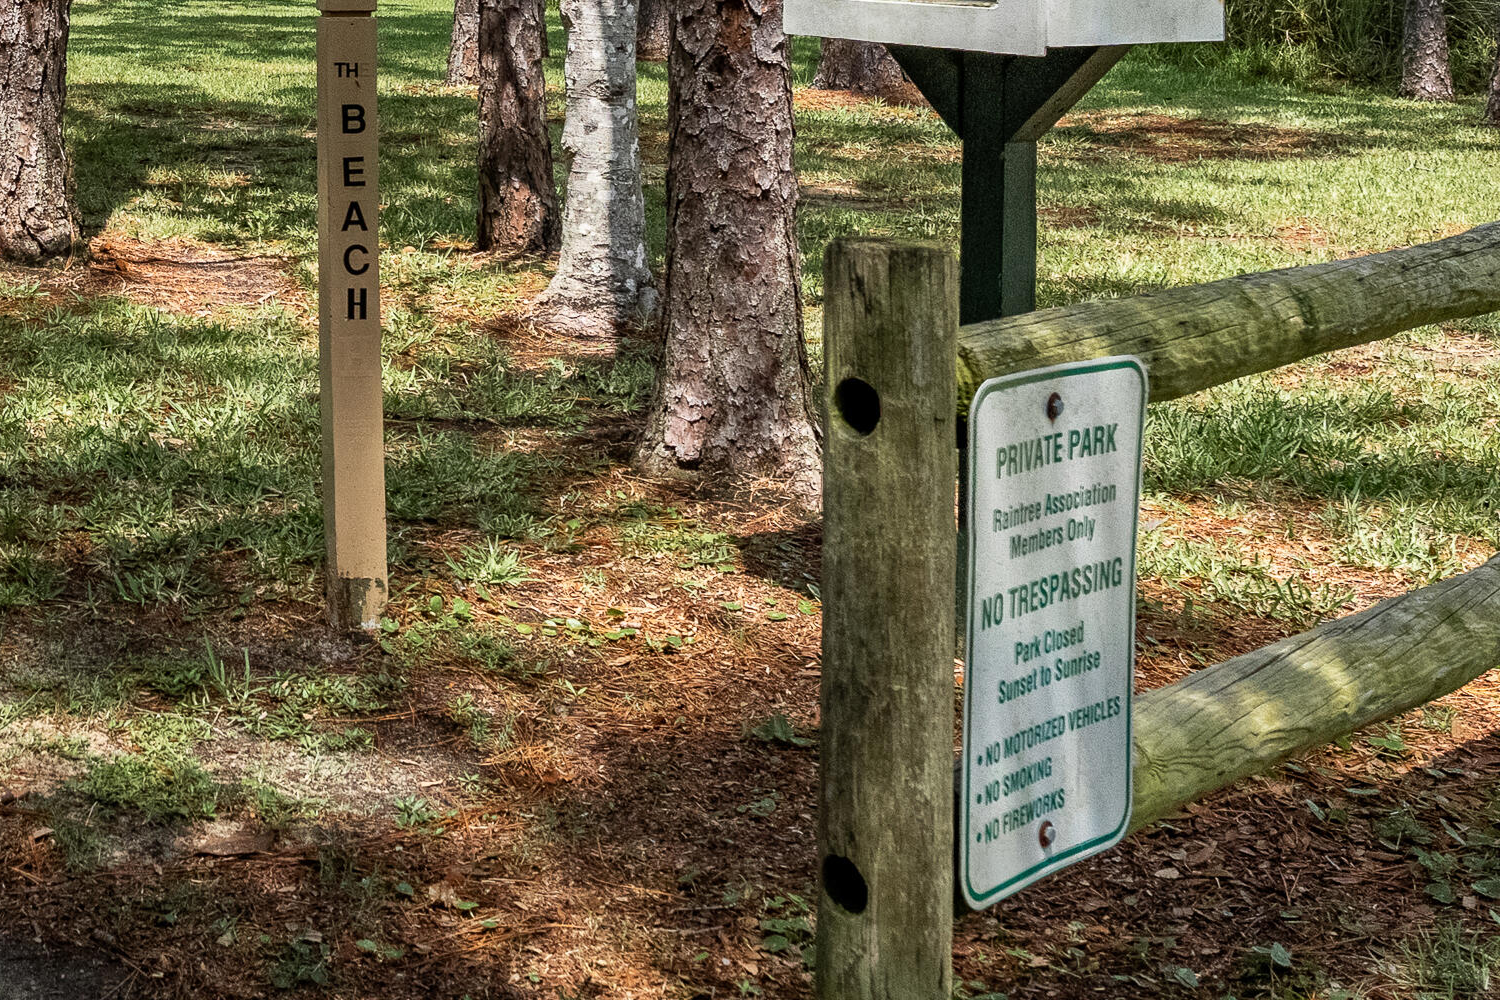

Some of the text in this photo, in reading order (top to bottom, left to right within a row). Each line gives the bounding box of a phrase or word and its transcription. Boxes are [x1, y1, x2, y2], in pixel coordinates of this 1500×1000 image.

[341, 104, 370, 320] BEACH
[996, 423, 1118, 479] PRIVATE PARK
[993, 483, 1117, 532] Raintree Association
[1010, 516, 1096, 559] Members Only
[981, 557, 1123, 631] NO TRESPASSING
[1014, 620, 1085, 665] Park Closed
[998, 649, 1100, 704] Sunset to Sunrise
[985, 696, 1121, 767] NO MOTORIZED VEHICLES
[985, 757, 1053, 806] NO SMOKING
[984, 788, 1066, 844] NO FIREWORKS
